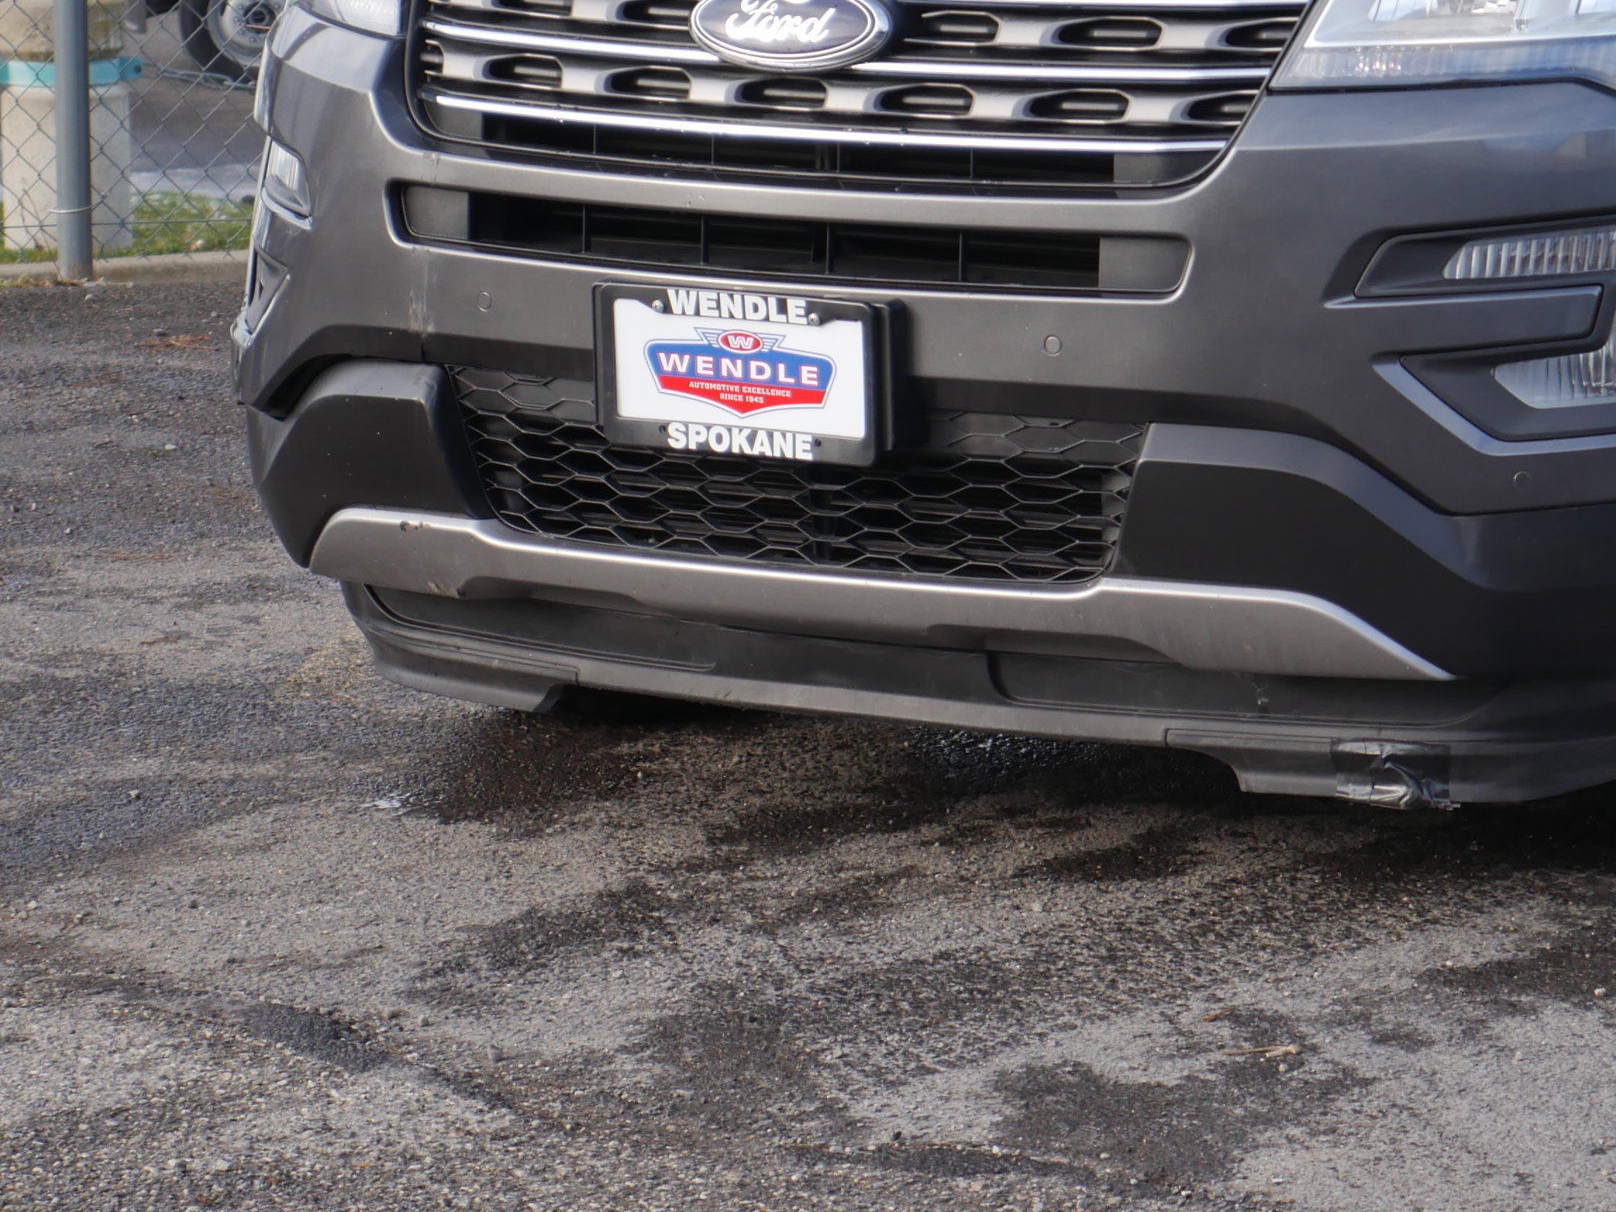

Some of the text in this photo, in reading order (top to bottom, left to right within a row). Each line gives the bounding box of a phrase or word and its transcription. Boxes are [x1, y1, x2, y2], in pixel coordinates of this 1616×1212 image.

[667, 289, 808, 324] WENDLE
[658, 352, 819, 386] WENDLE
[689, 381, 792, 397] AUTOMOTIVE EXCELLENCE
[720, 393, 764, 403] SINCE 1943
[667, 422, 813, 459] SPOKANE
